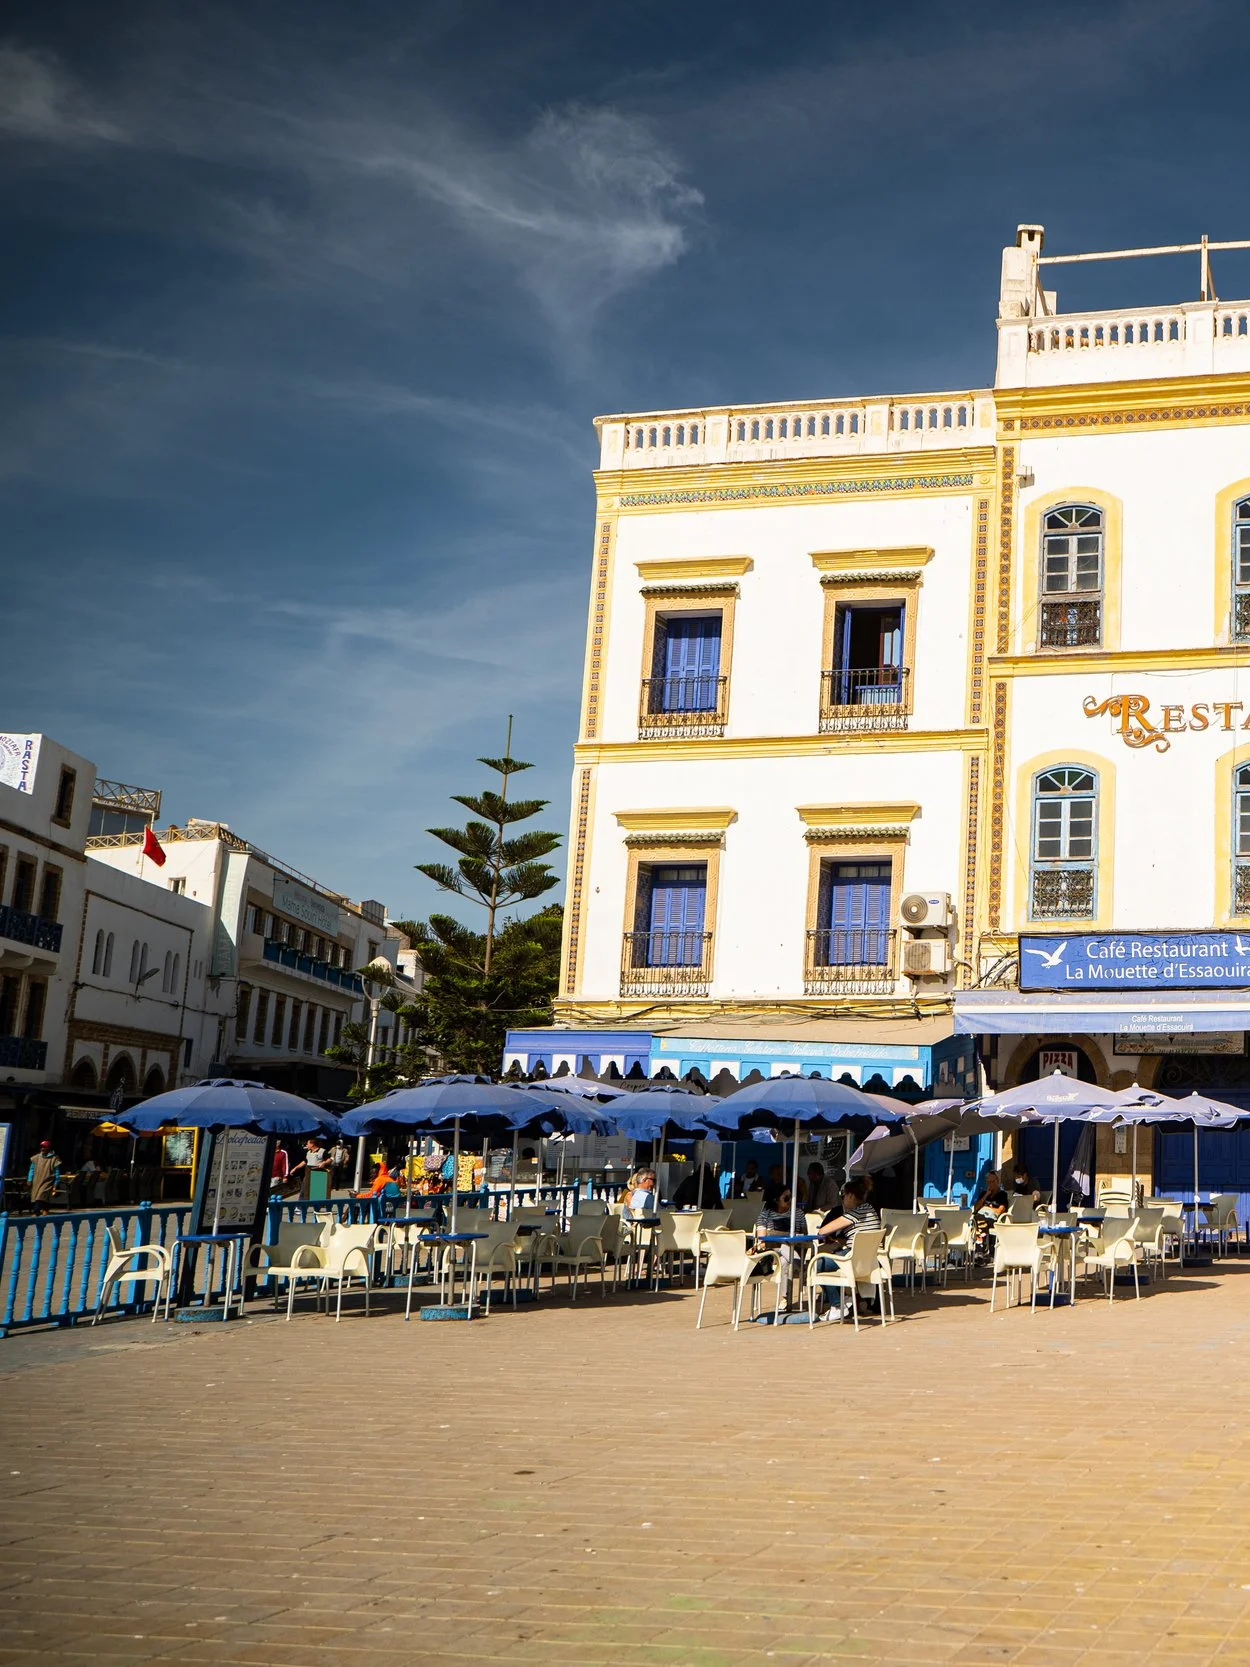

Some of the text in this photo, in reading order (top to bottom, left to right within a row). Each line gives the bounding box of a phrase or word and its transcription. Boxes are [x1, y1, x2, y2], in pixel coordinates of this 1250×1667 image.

[17, 740, 33, 791] RASTA
[1086, 941, 1228, 959] Café Restaurant
[1066, 965, 1084, 979] La
[1088, 964, 1157, 979] Mouette
[1131, 1014, 1183, 1023] Café Restaurant
[1043, 1053, 1073, 1070] PIZZA
